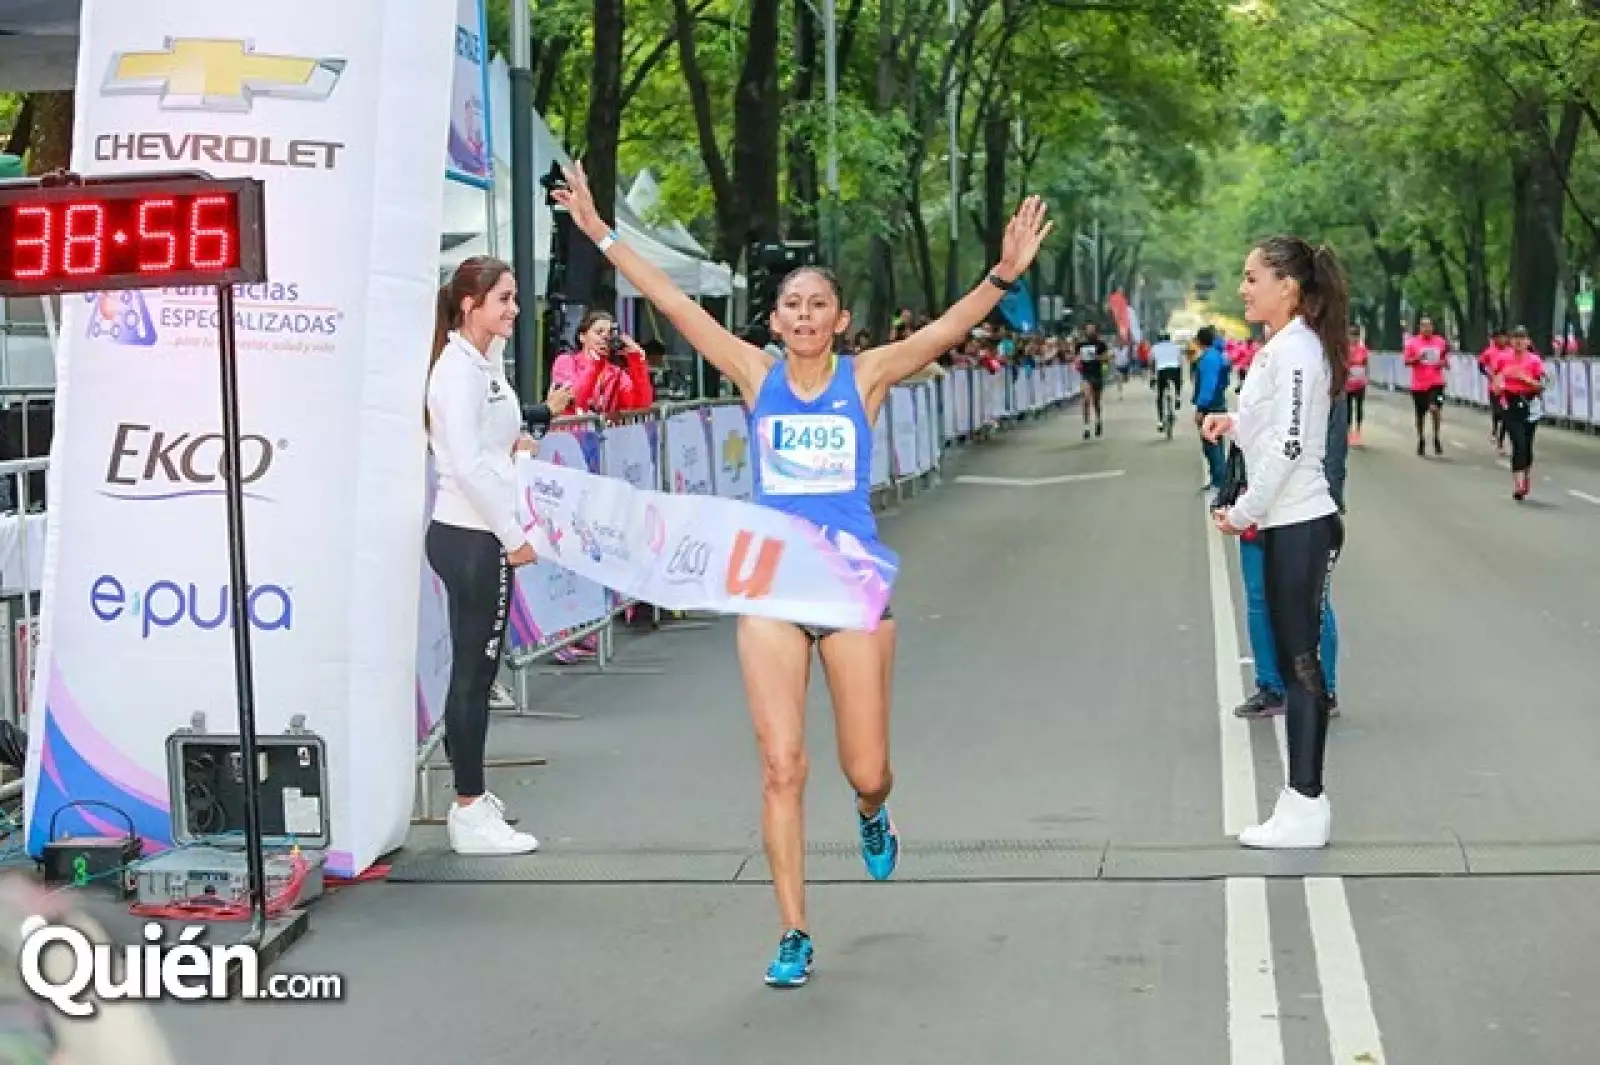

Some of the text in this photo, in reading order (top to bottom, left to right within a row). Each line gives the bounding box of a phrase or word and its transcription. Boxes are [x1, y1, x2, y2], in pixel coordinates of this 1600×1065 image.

[94, 131, 345, 170] CHEVROLET
[159, 307, 337, 334] ESPECALIZADAS
[106, 422, 274, 486] EKCO
